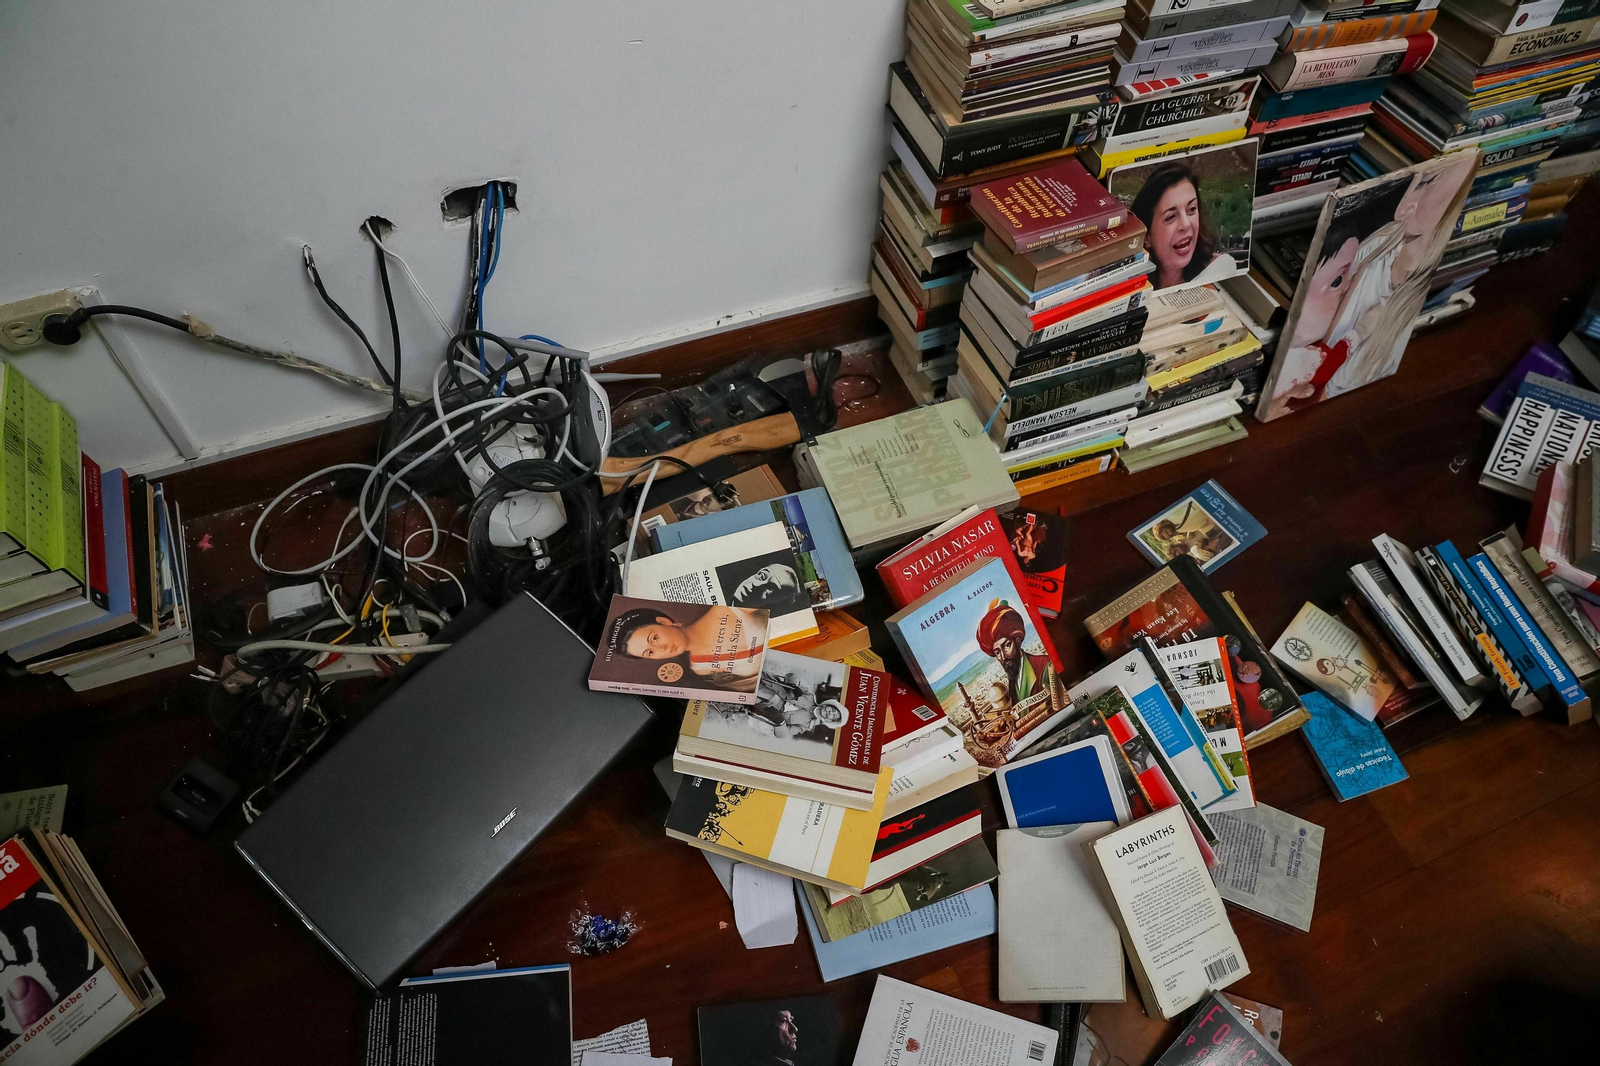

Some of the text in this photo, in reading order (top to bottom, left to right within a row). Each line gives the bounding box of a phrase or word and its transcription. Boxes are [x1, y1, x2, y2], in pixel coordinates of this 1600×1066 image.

[1193, 34, 1233, 48] VENEZUELA
[1536, 27, 1568, 39] SAMUELSON
[1507, 31, 1583, 56] ECONOMICS
[1180, 59, 1219, 73] VENEZUELA
[1302, 56, 1358, 74] LA REVOLUCIÓN
[1316, 69, 1337, 79] RUSA
[1150, 93, 1210, 112] LA GUERRA
[1145, 107, 1206, 127] CHURCHILL
[969, 144, 1001, 156] TONY JUDT
[1484, 148, 1516, 166] SOLAR
[1298, 157, 1322, 169] ESTADO
[1290, 172, 1313, 183] ESTADO
[1015, 180, 1054, 220] Bolivariana
[1022, 175, 1057, 210] Venezuela
[982, 186, 1024, 230] Constitución
[1002, 195, 1024, 216] de la
[1006, 185, 1041, 221] República
[1052, 207, 1067, 220] de
[1469, 208, 1506, 226] Animales
[1124, 258, 1145, 270] Fernando
[1090, 328, 1127, 344] ALEXANDER
[1012, 406, 1078, 431] NELSON MANDELA
[1494, 398, 1548, 479] HAPPINESS
[1540, 410, 1581, 476] NATIONAL
[872, 459, 888, 484] venezolano
[883, 482, 895, 499] pensar
[889, 497, 898, 506] del
[902, 518, 997, 582] SYLVIA NASAR
[920, 582, 930, 592] A
[972, 543, 996, 562] MIND
[702, 569, 715, 593] SAUL
[971, 580, 994, 597] BALDOR
[1442, 580, 1454, 592] Neil
[1465, 582, 1474, 592] 20
[1088, 571, 1168, 627] ASIAN ECONOMIC BOOM
[1099, 582, 1166, 629] SINGAPORE AND THE
[1502, 552, 1573, 645] Una Constitución para el Ciudadano
[918, 602, 956, 631] ALGEBRA
[1145, 614, 1166, 632] Kuan
[1164, 606, 1180, 620] Lee
[1464, 613, 1481, 633] William
[1474, 559, 1567, 684] Una Constitución para una Nueva República
[1485, 610, 1500, 628] España
[1130, 627, 1148, 642] Yew
[1179, 626, 1198, 644] TO
[1416, 596, 1470, 668] Leopoldo López Preso pero libre
[606, 643, 616, 663] SILVIA
[704, 614, 730, 682] La gloria eres tú,
[723, 618, 742, 680] Manuela Sáenz
[1165, 649, 1199, 660] JOSHUA
[1478, 636, 1518, 688] The Fourth Turning
[1191, 687, 1206, 698] Gap
[847, 671, 872, 766] JUAN VICENTE GÓMEZ
[1372, 745, 1387, 755] Peter
[862, 756, 870, 766] DE
[1333, 754, 1392, 779] Técnicas de dibujo
[28, 796, 37, 806] de
[32, 794, 46, 828] diálogos
[44, 792, 55, 816] Sobre
[487, 806, 521, 838] BOSE
[1115, 823, 1176, 860] LABYRINTHS
[1136, 850, 1172, 870] Jorge Luis Borges
[20, 1010, 58, 1045] dónde
[56, 989, 85, 1017] debe
[82, 975, 101, 994] ir?
[897, 1004, 905, 1013] DE
[899, 997, 906, 1005] LA
[889, 999, 915, 1066] GUA ESPAÑOLA
[890, 1012, 903, 1040] ACADEMIAS
[887, 1040, 895, 1048] DE
